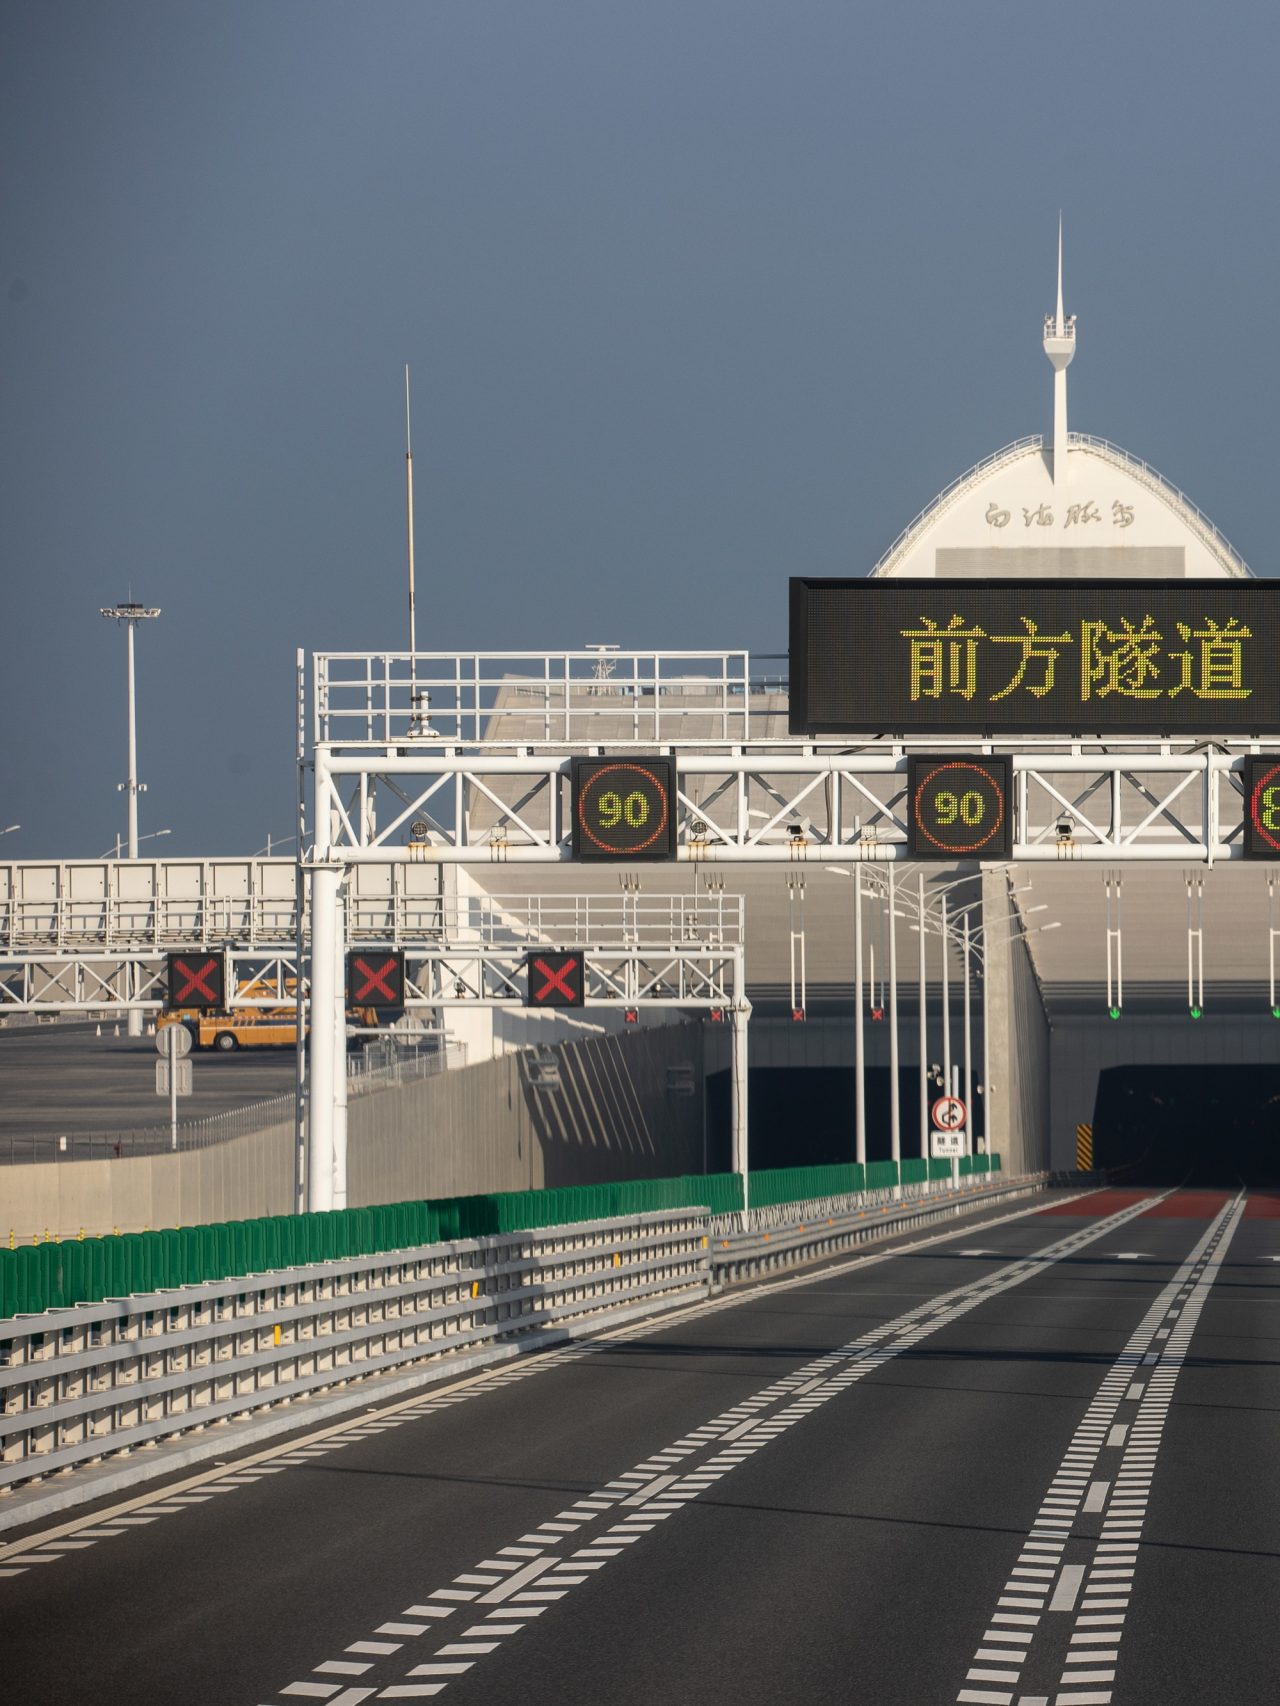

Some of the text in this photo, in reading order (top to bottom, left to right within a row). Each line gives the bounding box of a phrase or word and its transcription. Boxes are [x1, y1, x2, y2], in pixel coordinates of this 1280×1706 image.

[900, 614, 1253, 701] 前方隧道
[597, 790, 650, 829] 90
[934, 789, 986, 827] 90
